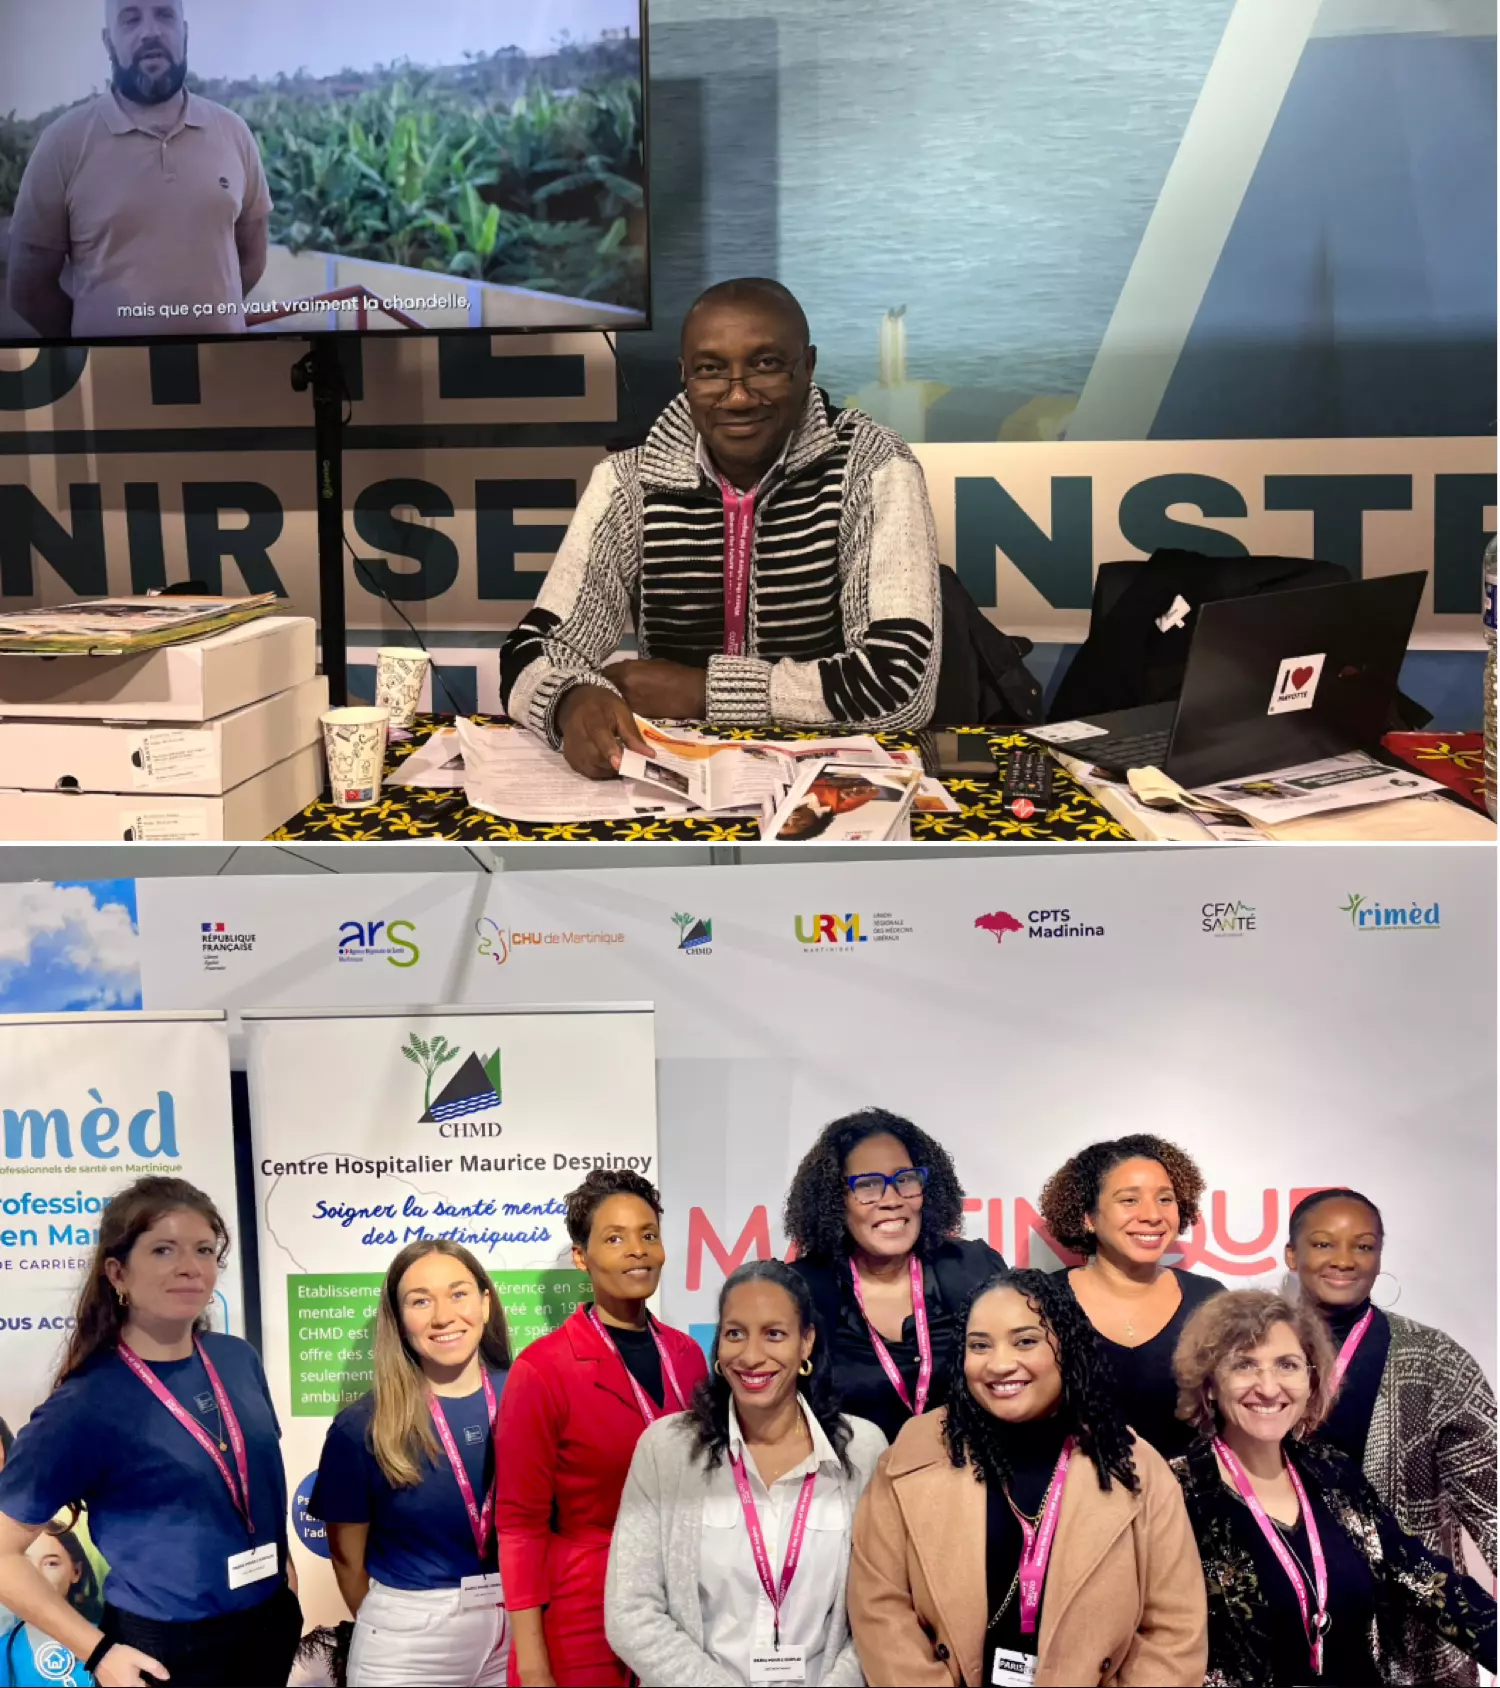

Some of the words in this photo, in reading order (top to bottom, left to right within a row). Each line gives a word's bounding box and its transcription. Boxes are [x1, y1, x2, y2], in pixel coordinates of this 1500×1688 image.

[118, 304, 155, 316] mais
[159, 304, 189, 320] que
[193, 302, 213, 319] ça
[217, 302, 237, 315] en
[242, 299, 279, 314] vaut
[283, 296, 358, 313] vraiment
[364, 295, 379, 311] la
[382, 294, 472, 312] chandelle,
[1028, 909, 1070, 923] CPTS
[1358, 902, 1440, 926] rimèd
[1202, 914, 1256, 932] SANTÉ
[202, 934, 256, 943] RÉPUBLIQUE
[512, 932, 542, 945] CHU
[544, 933, 560, 944] de
[562, 933, 625, 945] Martinique
[1028, 924, 1105, 939] Madinina
[202, 943, 253, 952] FRANÇAISE
[439, 1122, 502, 1137] CHMD
[64, 1164, 77, 1173] de
[79, 1163, 107, 1173] santé
[125, 1163, 182, 1174] Martinique
[261, 1158, 328, 1176] Centre
[335, 1155, 453, 1178] Hospitalier
[460, 1153, 547, 1173] Maurice
[553, 1151, 653, 1174] Despinoy
[312, 1199, 397, 1228] Soigner
[403, 1195, 429, 1218] la
[432, 1199, 497, 1218] santé
[362, 1226, 397, 1246] des
[403, 1226, 552, 1254] Martiniquais
[553, 1283, 571, 1294] en
[298, 1306, 355, 1319] mentale
[534, 1304, 552, 1315] en
[299, 1327, 343, 1340] CHMD
[348, 1329, 369, 1340] est
[300, 1348, 333, 1361] offre
[337, 1348, 363, 1361] des
